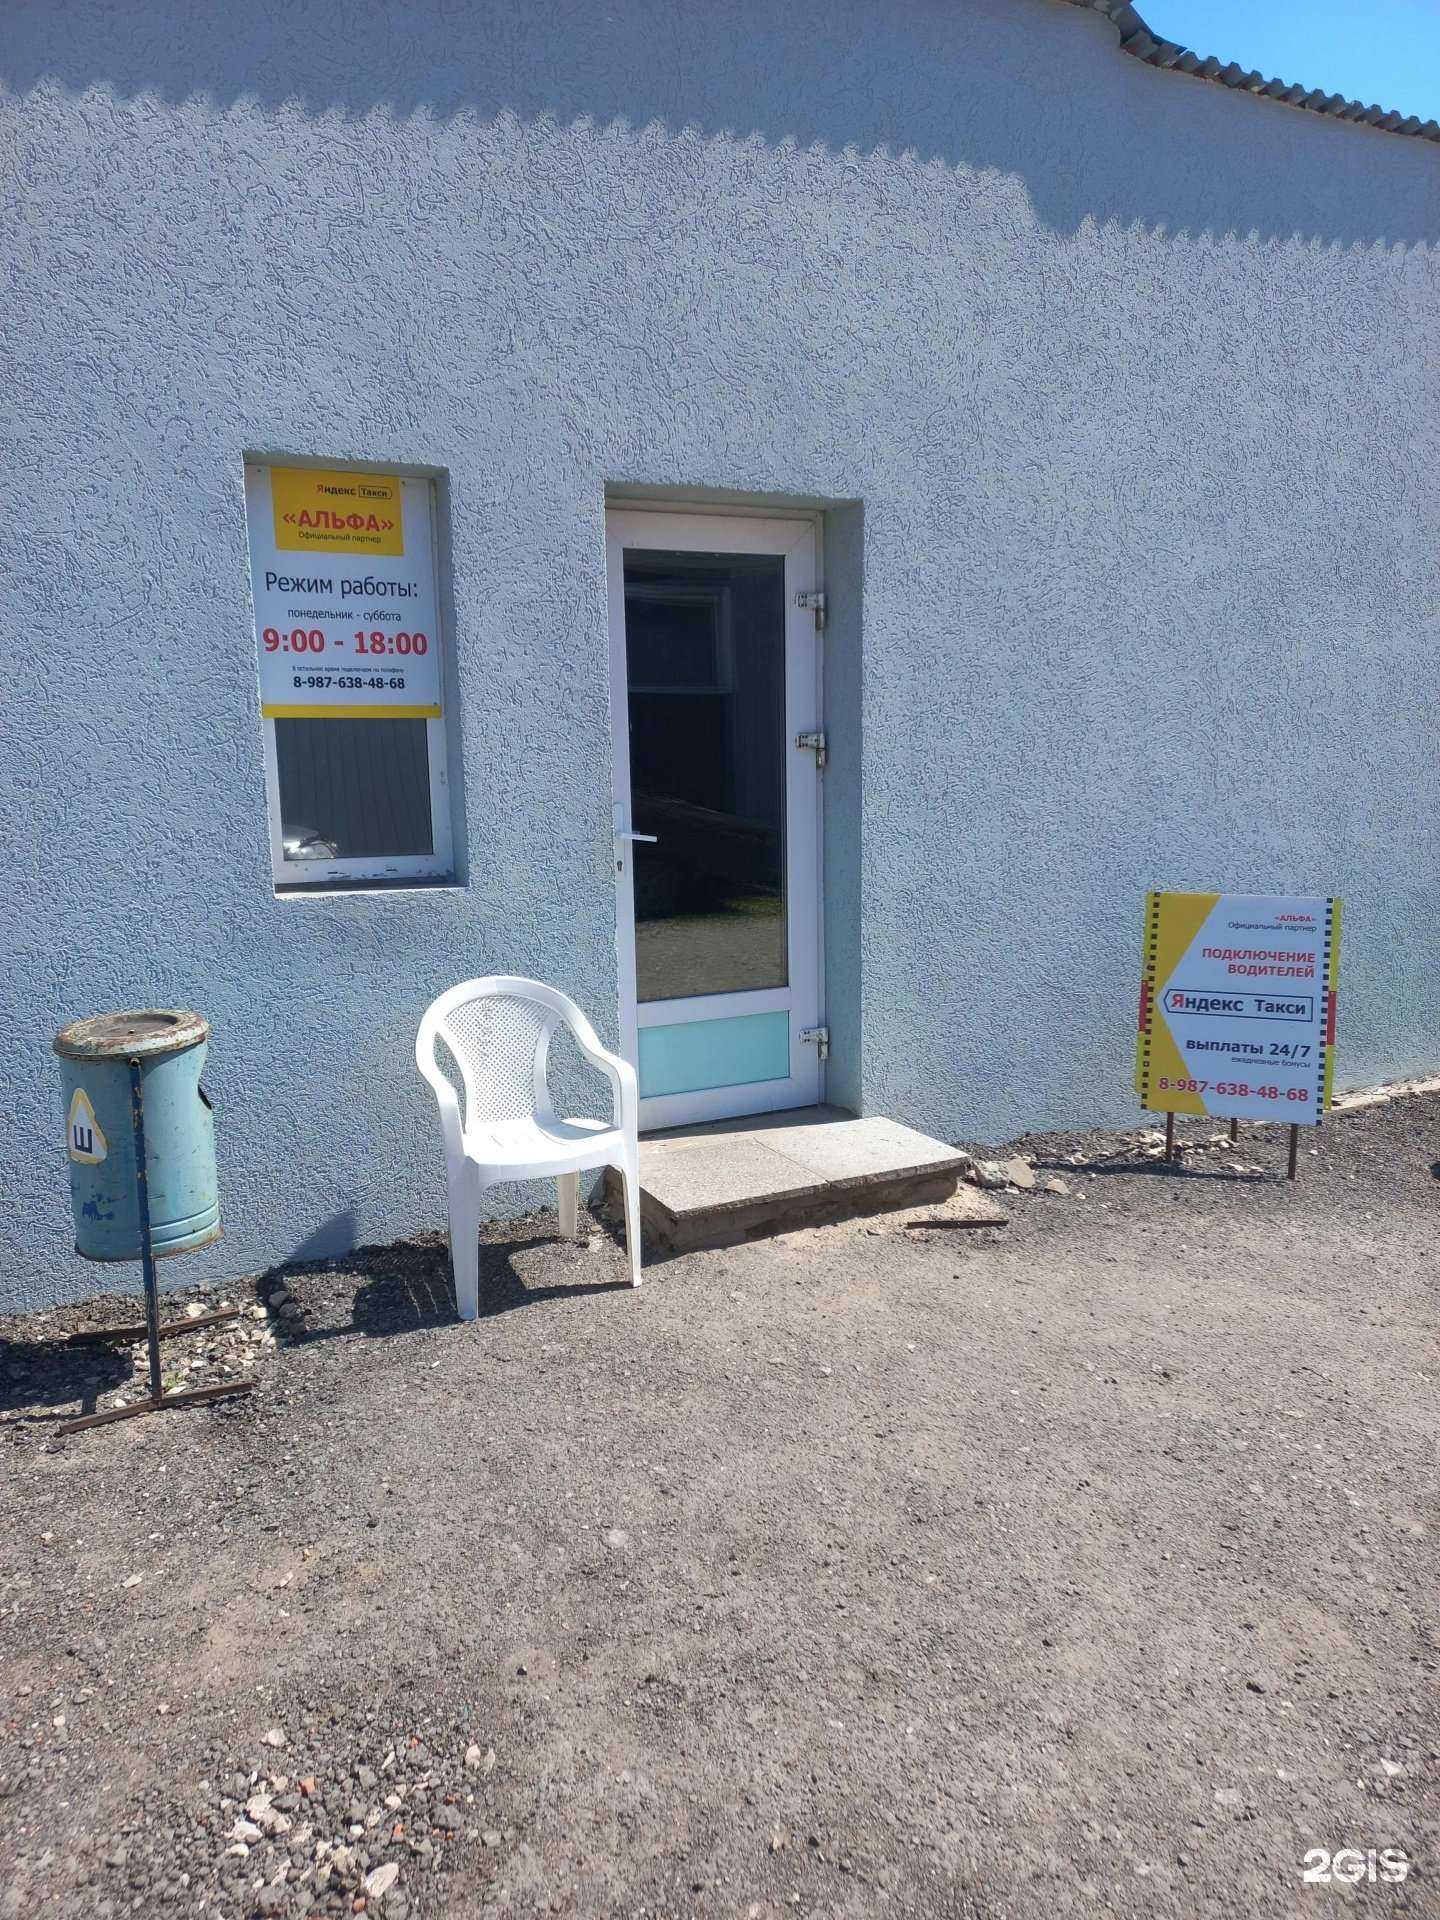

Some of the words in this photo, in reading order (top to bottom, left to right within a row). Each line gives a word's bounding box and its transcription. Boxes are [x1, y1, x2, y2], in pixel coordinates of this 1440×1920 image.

[316, 484, 356, 496] Яндекс
[361, 487, 388, 497] Такси
[282, 510, 395, 532] «АЛЬФА»
[298, 531, 350, 542] Официальный
[352, 535, 382, 544] партнер
[265, 571, 333, 593] Режим
[341, 576, 419, 599] работы:
[287, 609, 353, 620] понедельник
[363, 610, 402, 622] суббота
[262, 628, 325, 653] 9:00
[354, 631, 428, 656] 18:00
[293, 676, 405, 689] 8-987-638-48-68
[1228, 921, 1283, 931] Официальный
[1284, 924, 1317, 933] партнер
[1202, 948, 1316, 963] ПОДКЛЮЧЕНИЕ
[1228, 963, 1315, 978] ВОДИТЕЛЕЙ
[1171, 993, 1244, 1012] Яндекс
[1254, 999, 1306, 1015] Такси
[1186, 1039, 1264, 1055] выплаты
[1269, 1043, 1312, 1058] 24/7
[1159, 1077, 1309, 1102] 8-987-638-48-68
